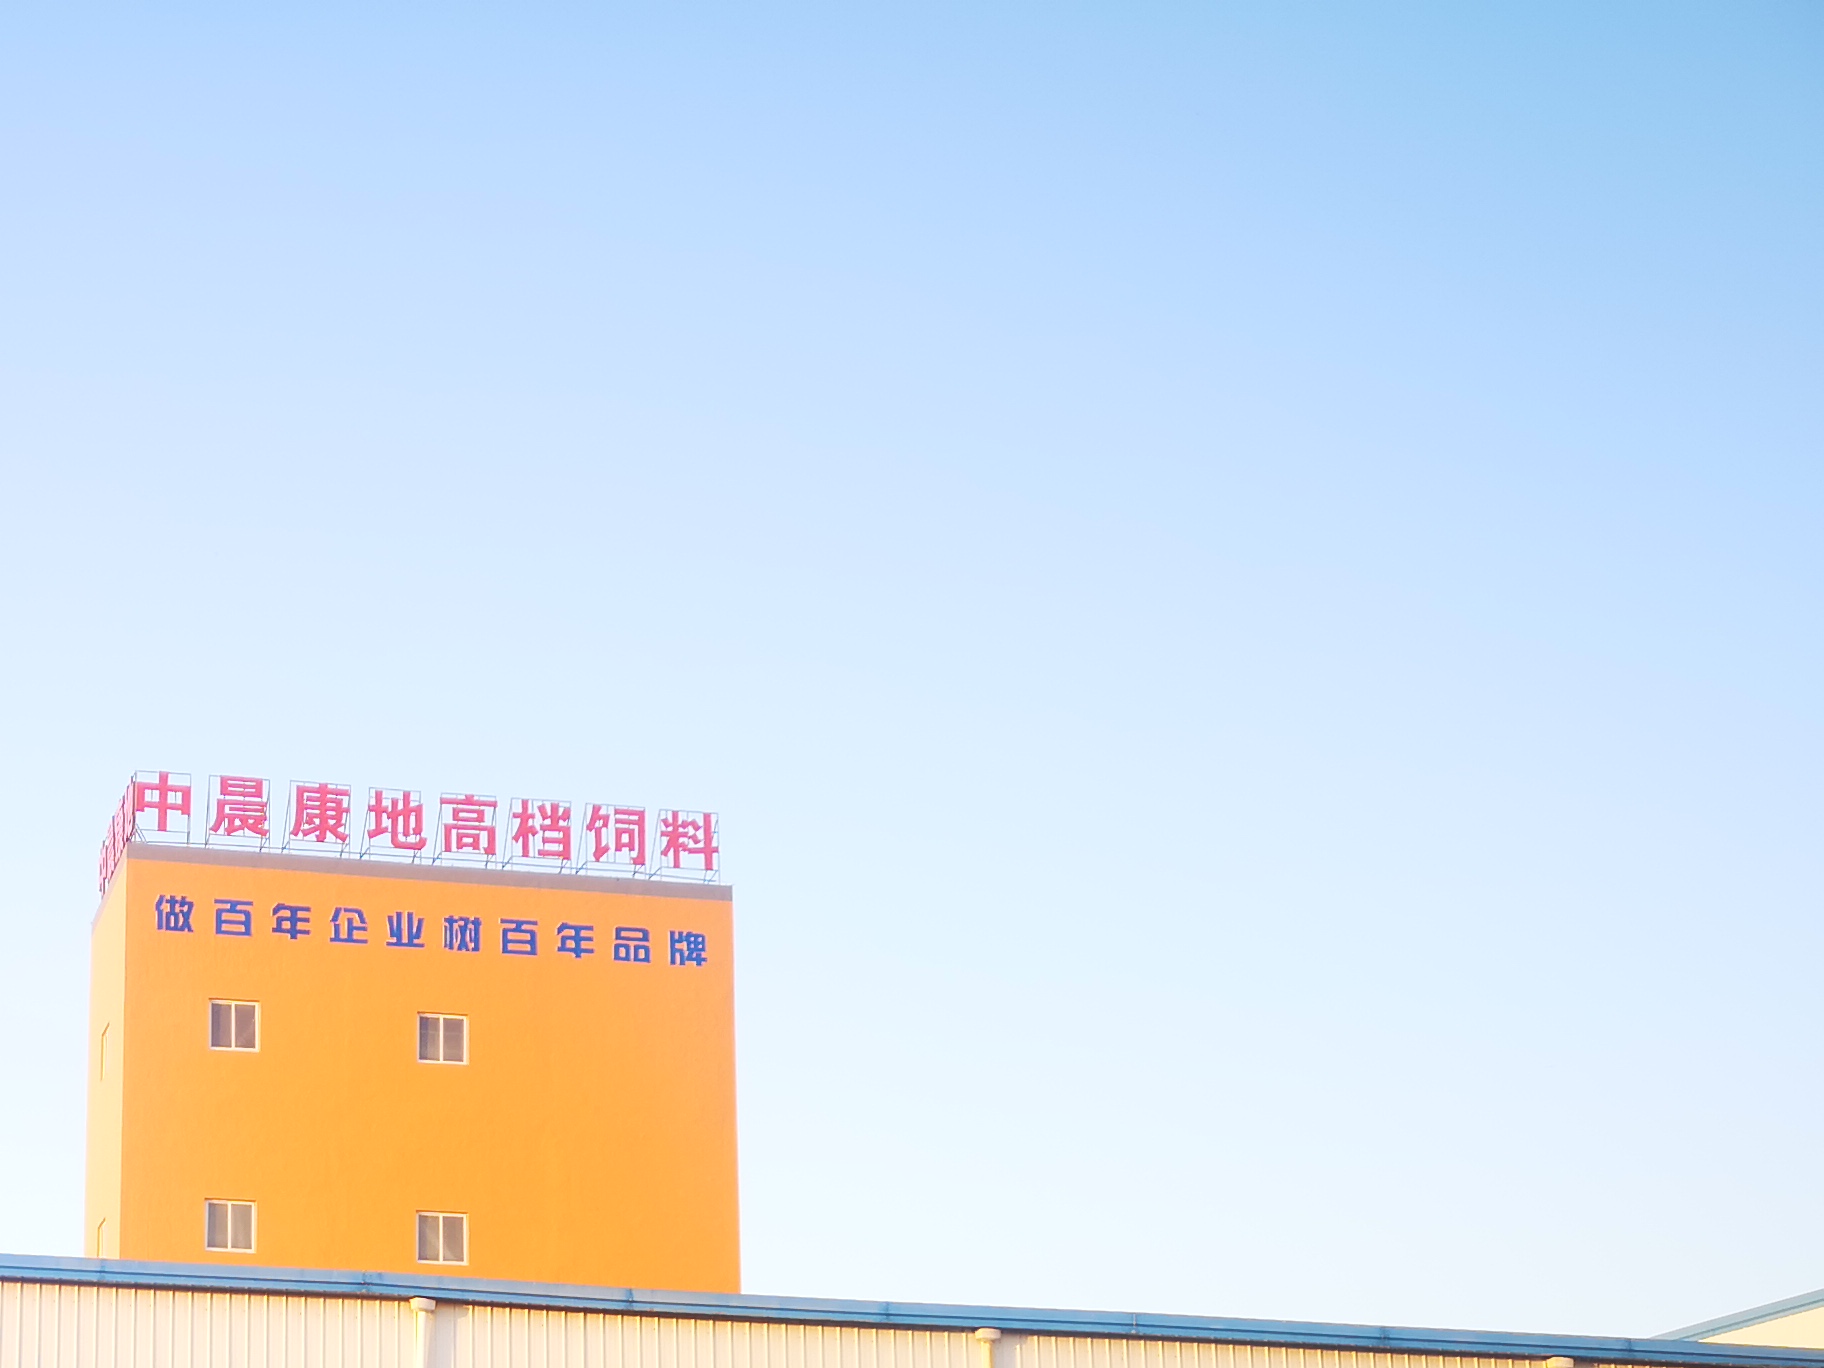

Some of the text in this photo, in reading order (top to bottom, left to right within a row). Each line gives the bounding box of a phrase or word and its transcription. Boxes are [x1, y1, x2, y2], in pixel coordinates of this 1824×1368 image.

[135, 771, 719, 871] 中晨康地高档饲料
[155, 894, 708, 967] 做百年企业树百年品牌
